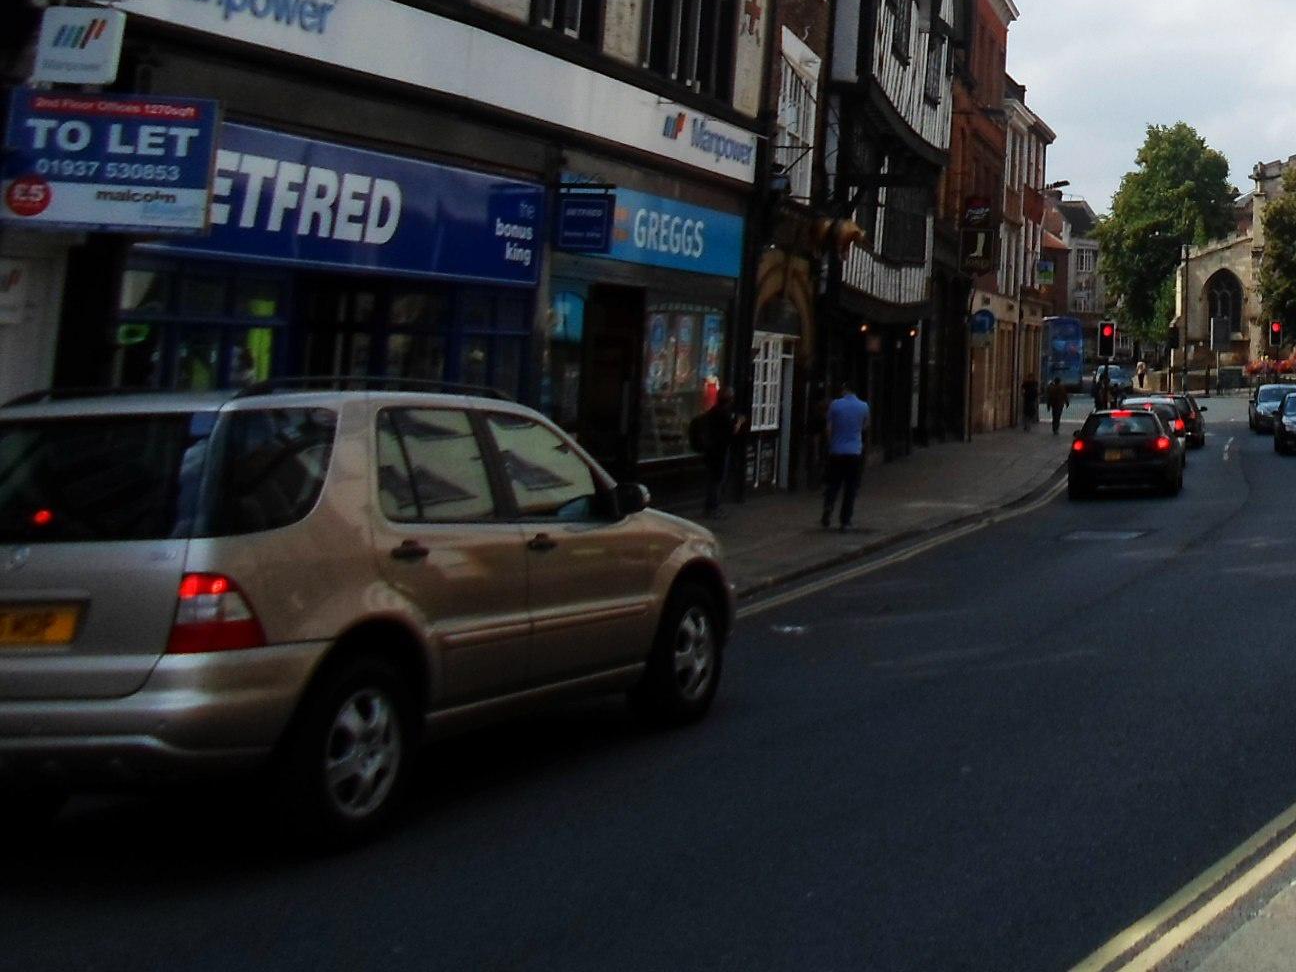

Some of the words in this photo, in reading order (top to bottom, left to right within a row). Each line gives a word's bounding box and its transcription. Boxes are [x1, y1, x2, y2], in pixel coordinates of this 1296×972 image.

[26, 118, 93, 152] TO
[107, 123, 200, 158] LET
[691, 117, 754, 165] Manpower
[35, 158, 100, 177] 01937
[105, 162, 182, 182] 530853
[96, 188, 177, 204] malcolm
[209, 148, 403, 246] ETFRED
[495, 217, 534, 241] bonus
[633, 207, 706, 260] GREGGS
[505, 240, 532, 267] king
